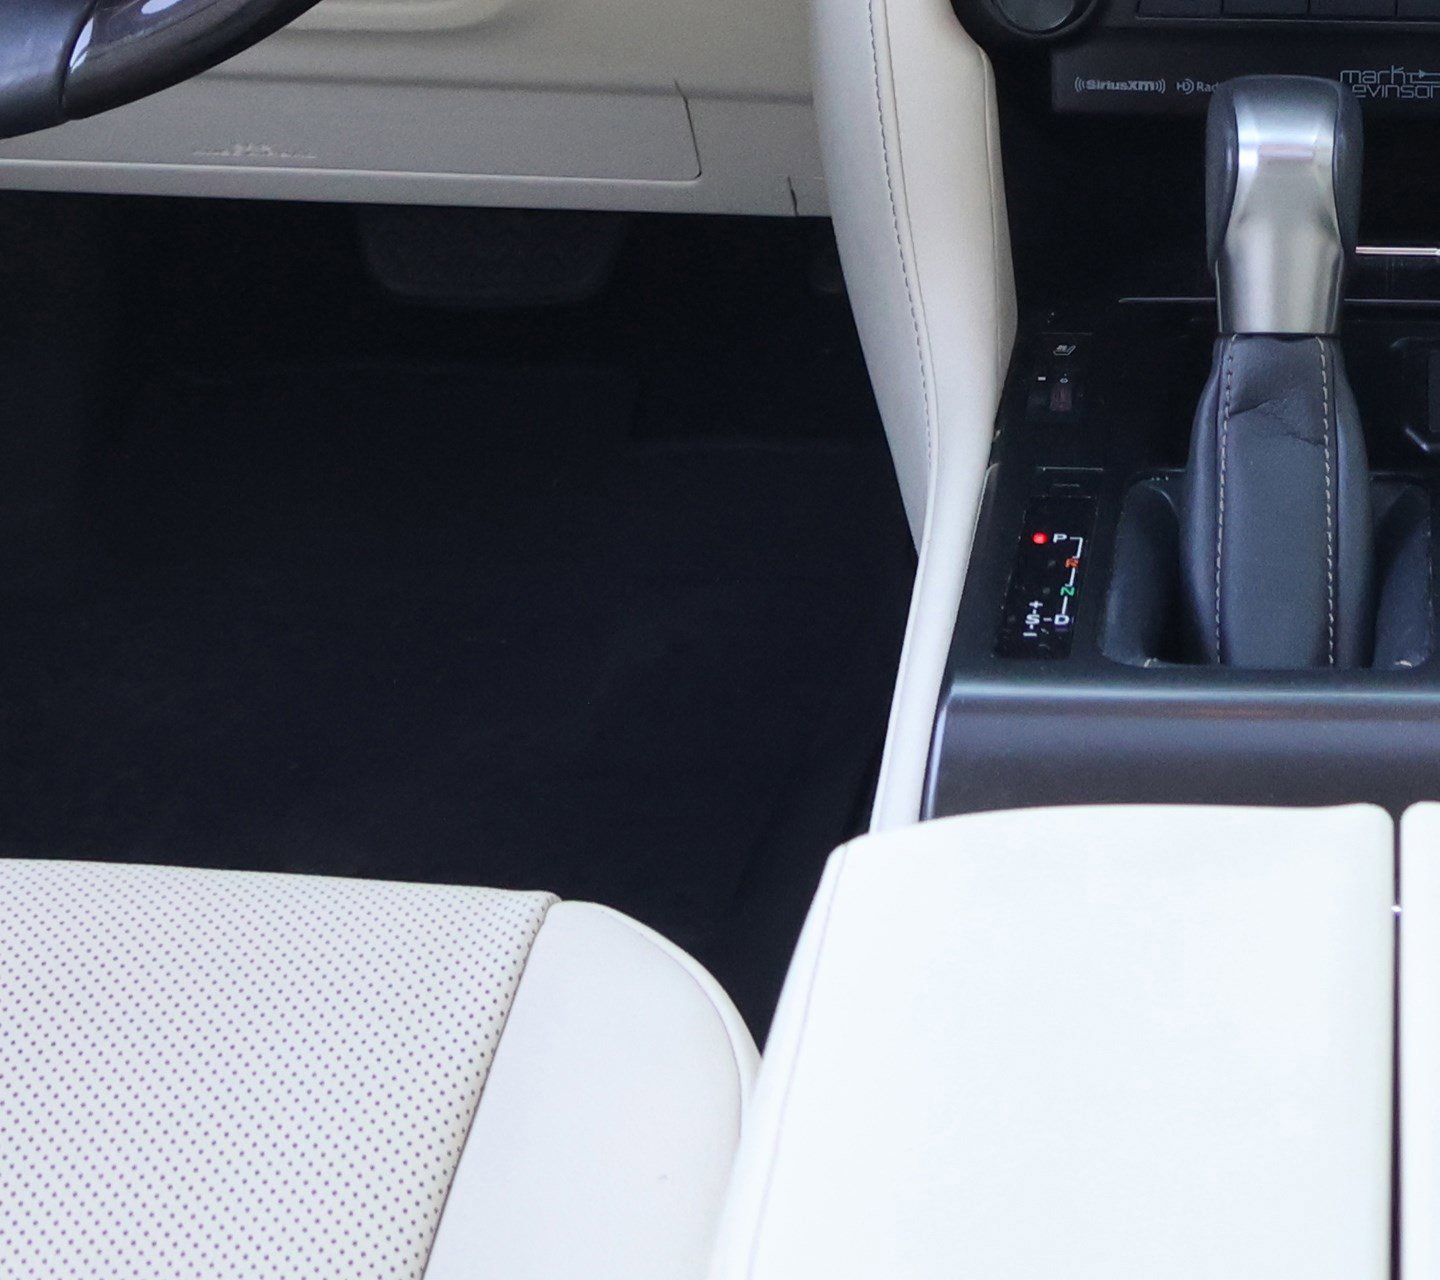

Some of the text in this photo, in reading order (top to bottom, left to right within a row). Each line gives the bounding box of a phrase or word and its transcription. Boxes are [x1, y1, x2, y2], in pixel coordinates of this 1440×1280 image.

[1340, 65, 1405, 85] mark
[1196, 81, 1217, 92] Rad
[1052, 533, 1068, 544] P
[1060, 586, 1075, 597] N
[1054, 613, 1070, 626] D
